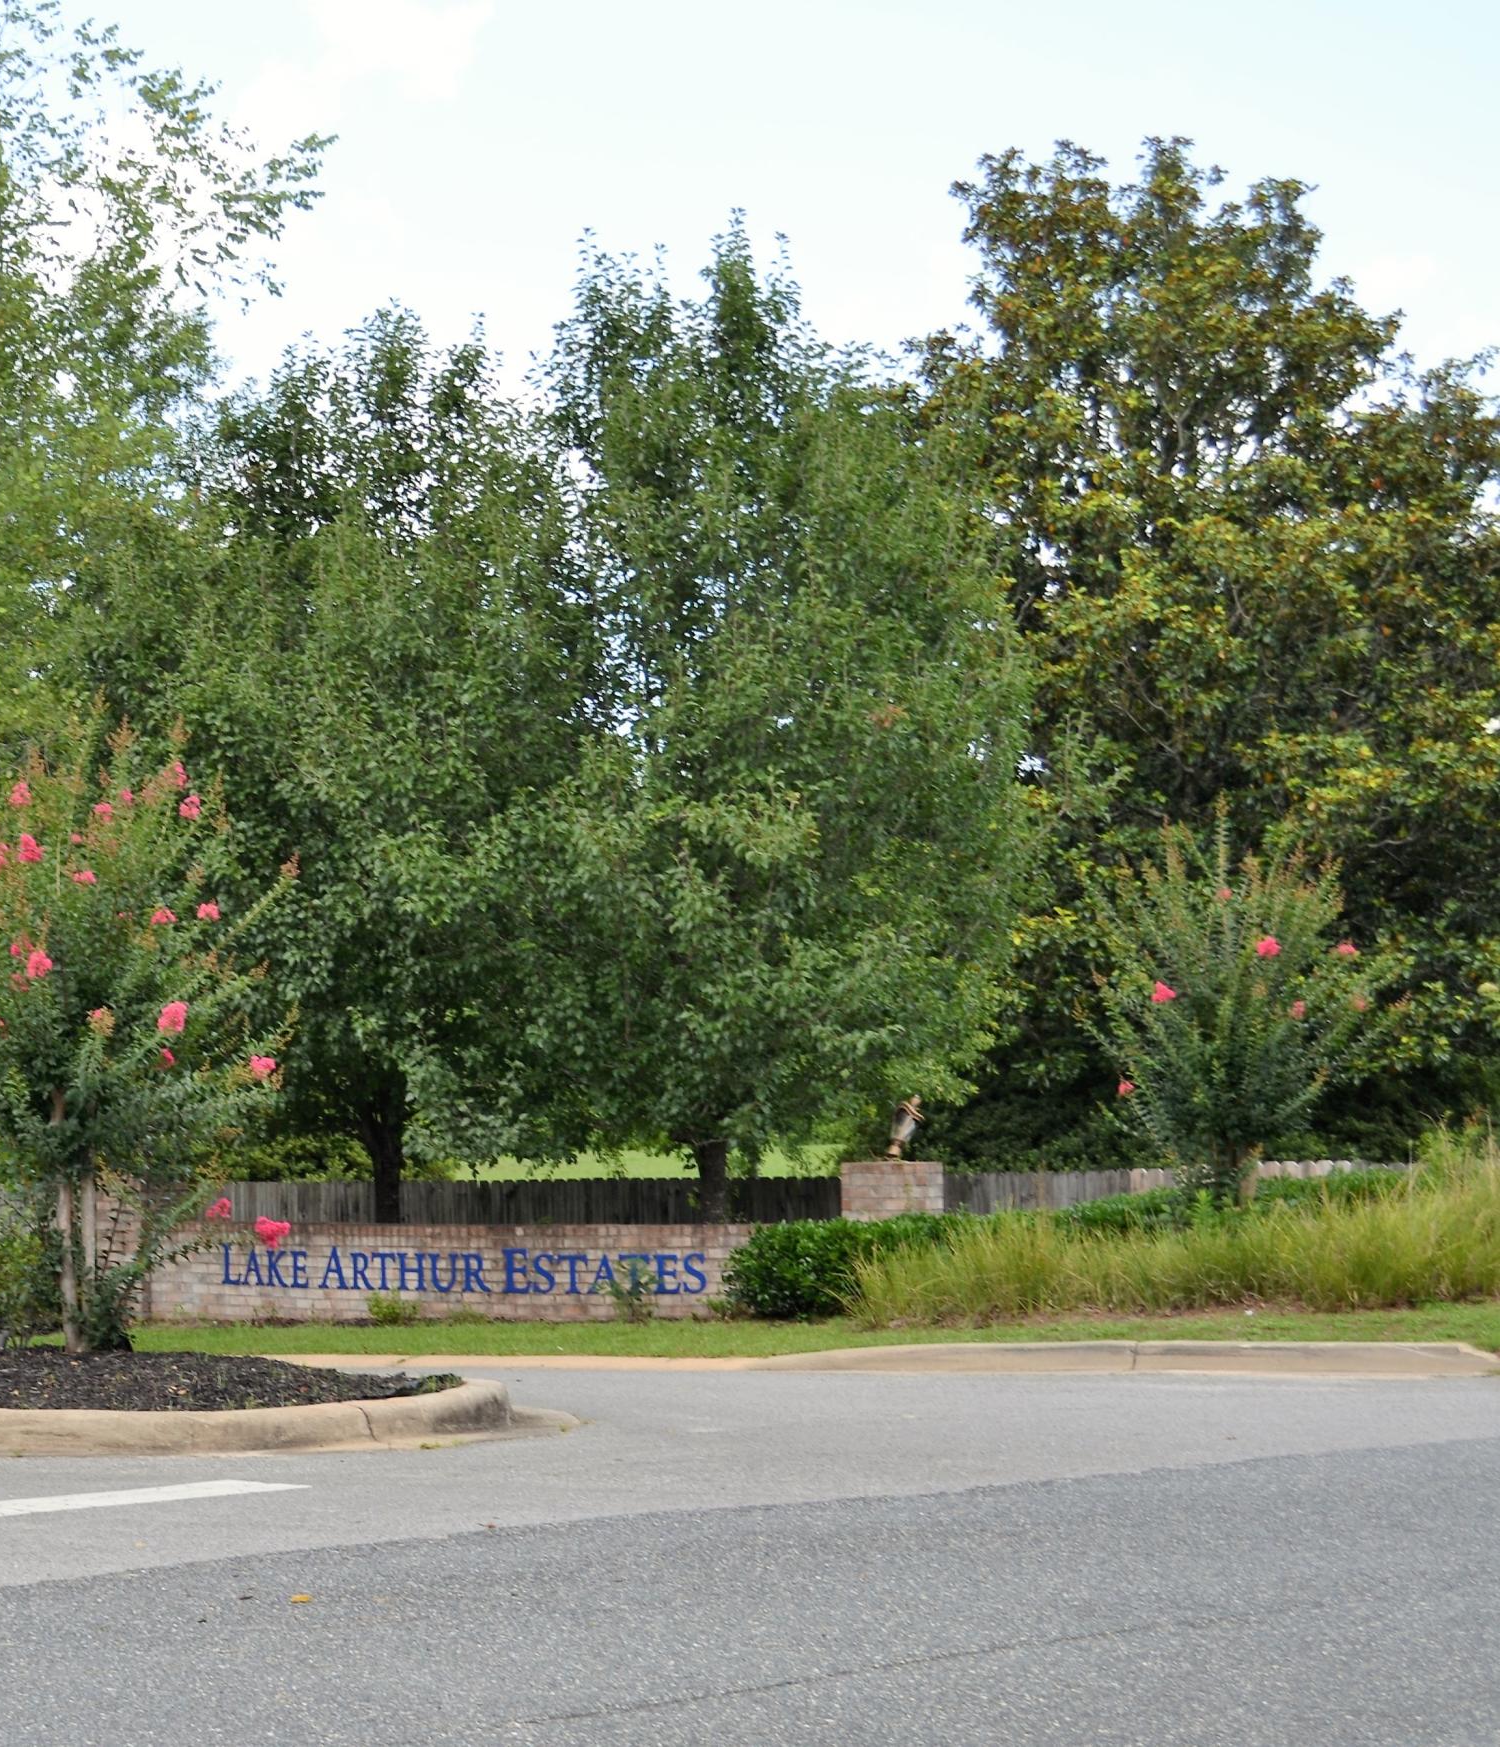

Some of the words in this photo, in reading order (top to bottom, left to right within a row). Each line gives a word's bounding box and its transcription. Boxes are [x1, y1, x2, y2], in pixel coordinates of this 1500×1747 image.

[221, 1242, 309, 1289] LAKE
[318, 1245, 492, 1293] ARTHUR
[501, 1247, 708, 1295] ESTATES
